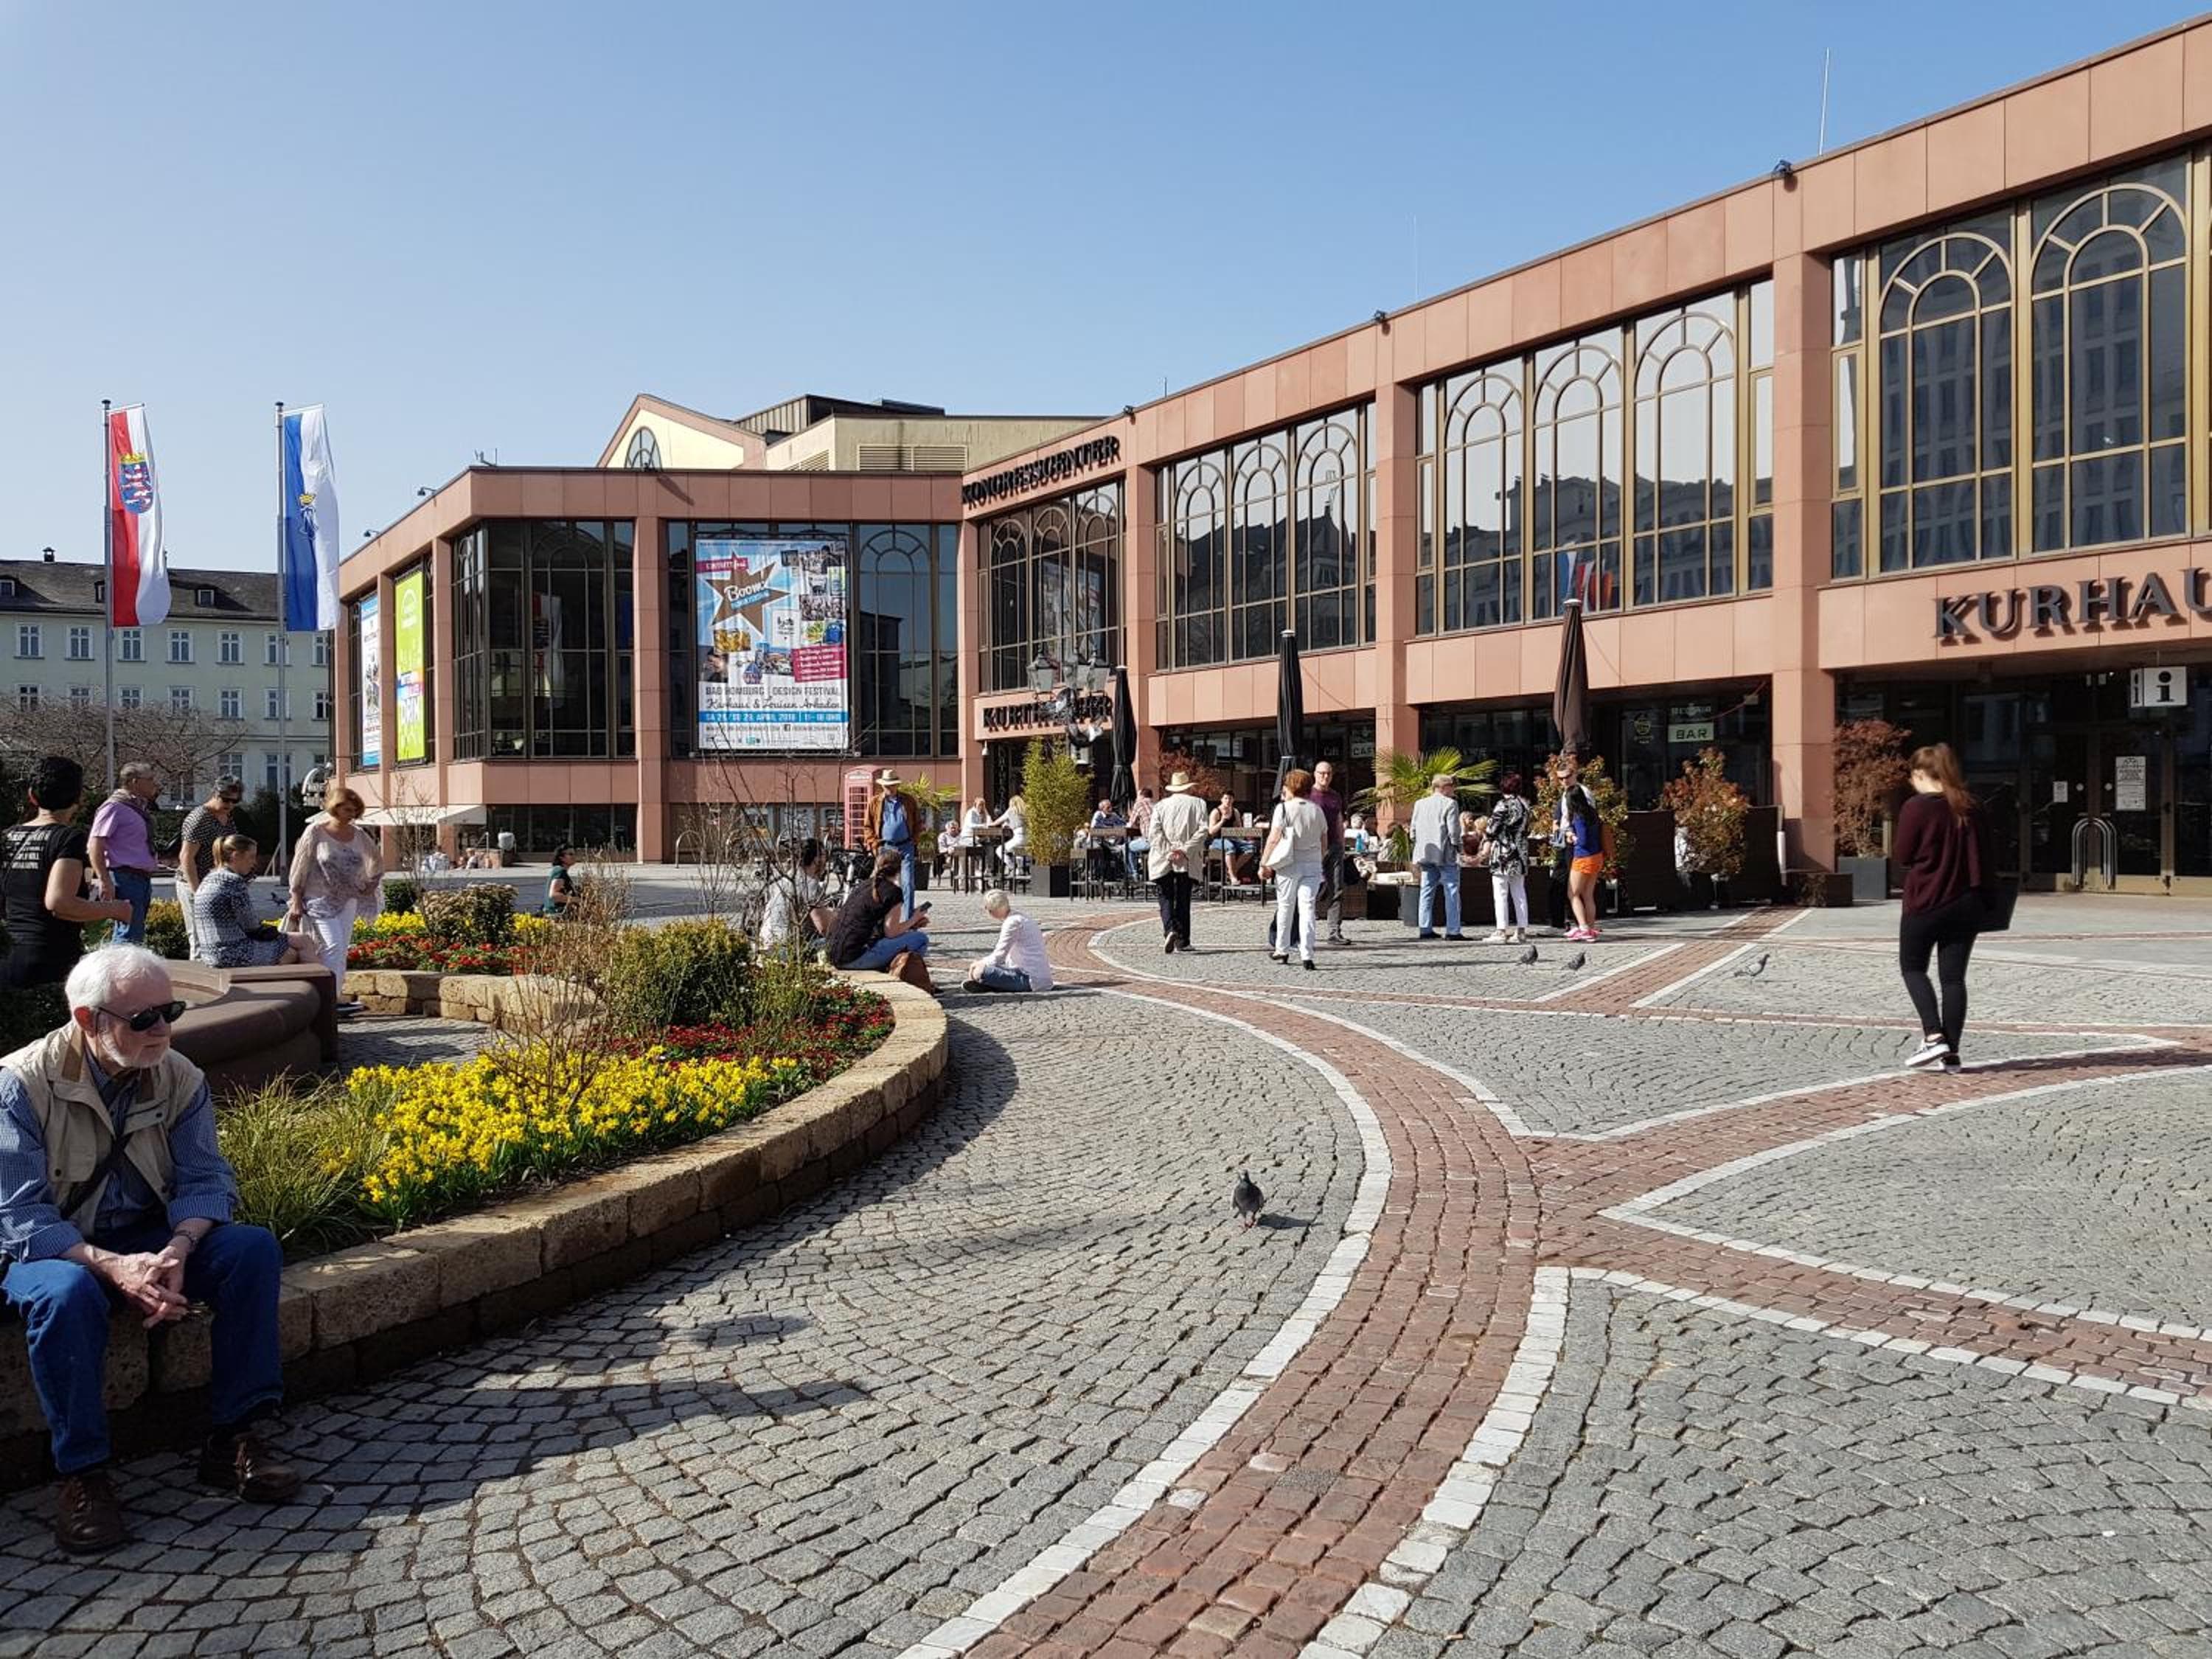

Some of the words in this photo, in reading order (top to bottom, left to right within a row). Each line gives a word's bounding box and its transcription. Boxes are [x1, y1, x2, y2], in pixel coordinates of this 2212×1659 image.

[706, 686, 722, 695] BAD
[726, 686, 765, 695] HOMBURG
[772, 686, 801, 695] DESIGN
[804, 686, 840, 695] FESTIVAL
[706, 698, 750, 709] Kurhaus
[799, 698, 840, 709] Arkaden
[1676, 729, 1708, 740] BAR
